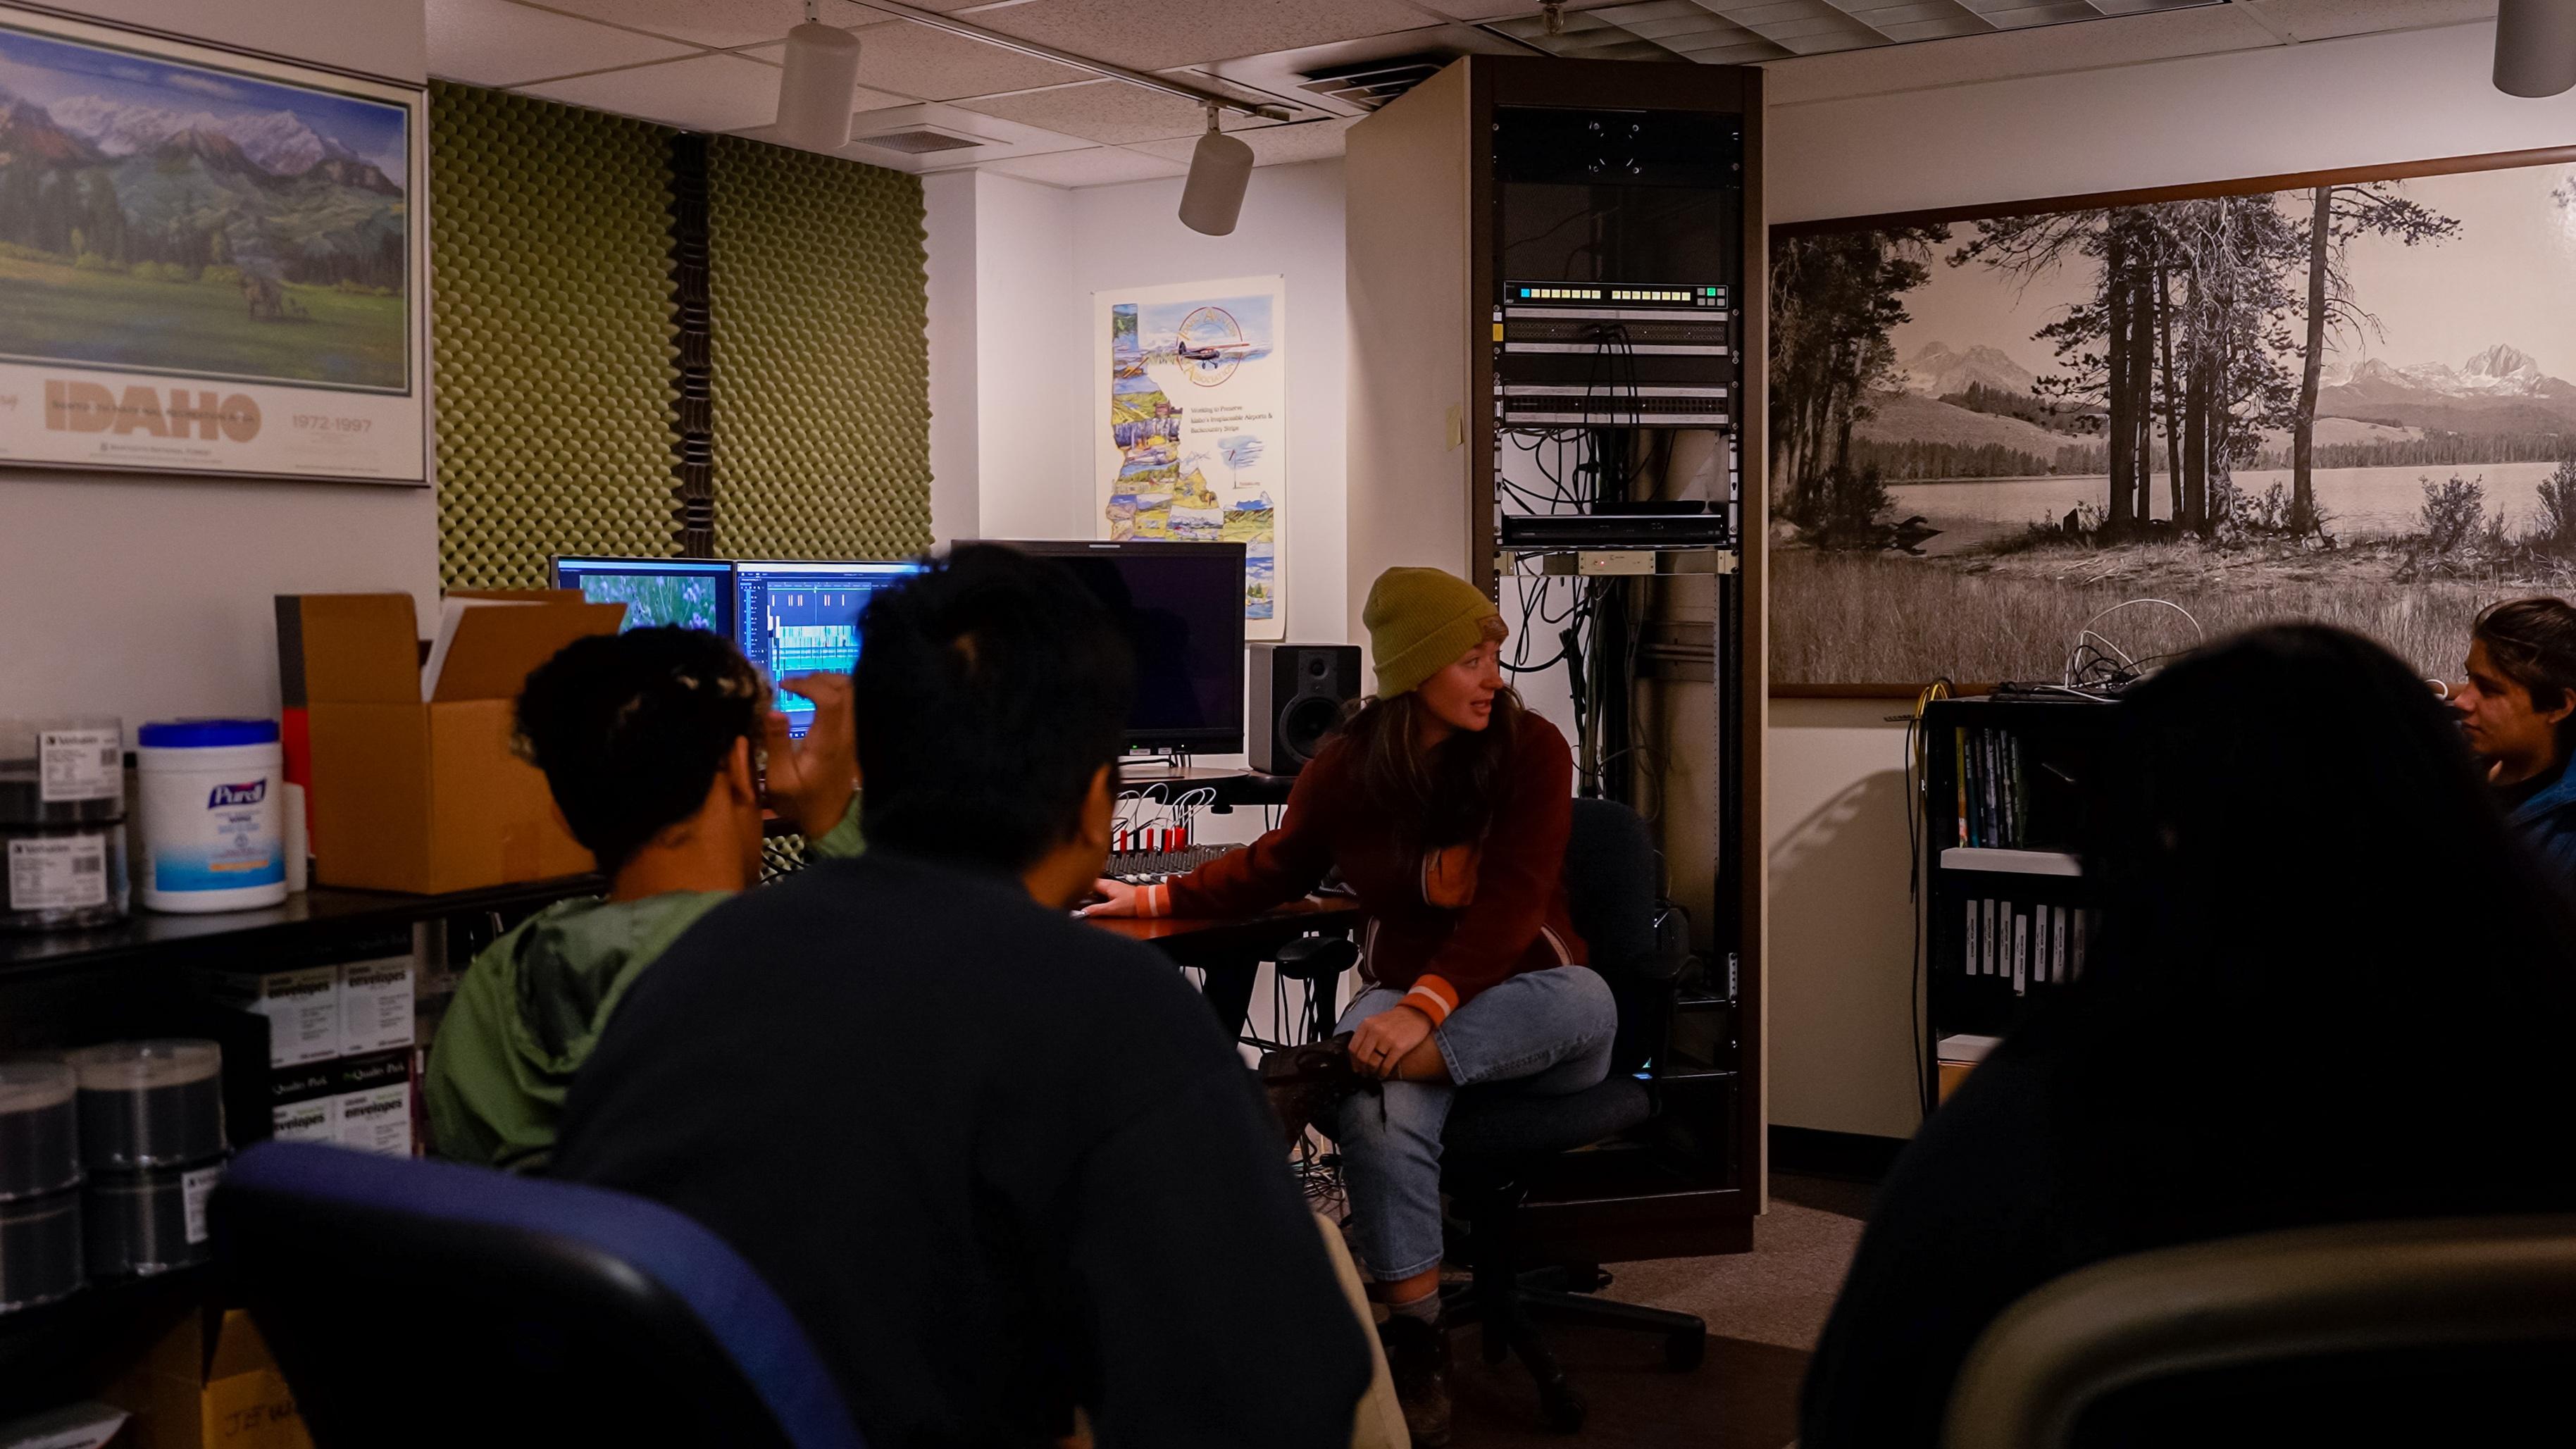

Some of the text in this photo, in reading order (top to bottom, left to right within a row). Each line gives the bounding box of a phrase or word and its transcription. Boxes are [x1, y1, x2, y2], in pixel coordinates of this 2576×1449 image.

[45, 379, 261, 443] IDAHO
[349, 969, 406, 987] envelopes
[344, 1099, 402, 1119] envelopes
